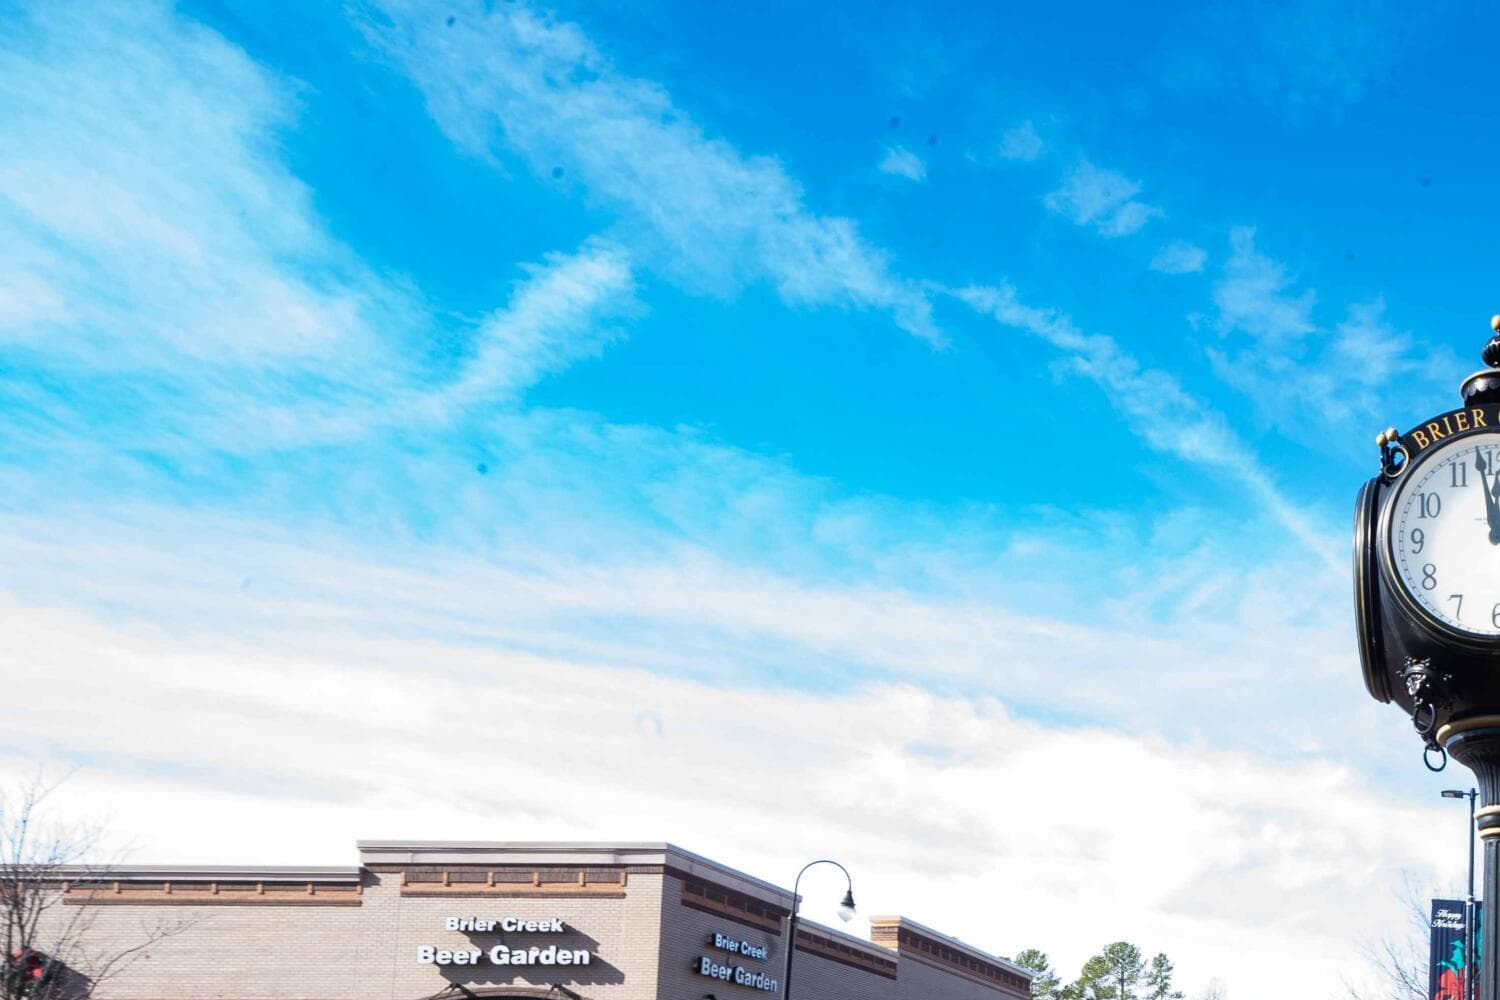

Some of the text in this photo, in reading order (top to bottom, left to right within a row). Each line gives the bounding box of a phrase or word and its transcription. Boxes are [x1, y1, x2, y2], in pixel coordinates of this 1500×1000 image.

[1411, 408, 1487, 449] BRIER
[1450, 462, 1468, 488] 11
[1418, 492, 1442, 519] 10
[1411, 528, 1424, 554] 9
[1421, 563, 1437, 591] 8
[1448, 594, 1464, 621] 7
[445, 916, 563, 933] Brier Creek
[416, 944, 590, 965] Beer Garden
[715, 933, 768, 960] Brier Creek
[701, 956, 778, 992] Beer Garden
